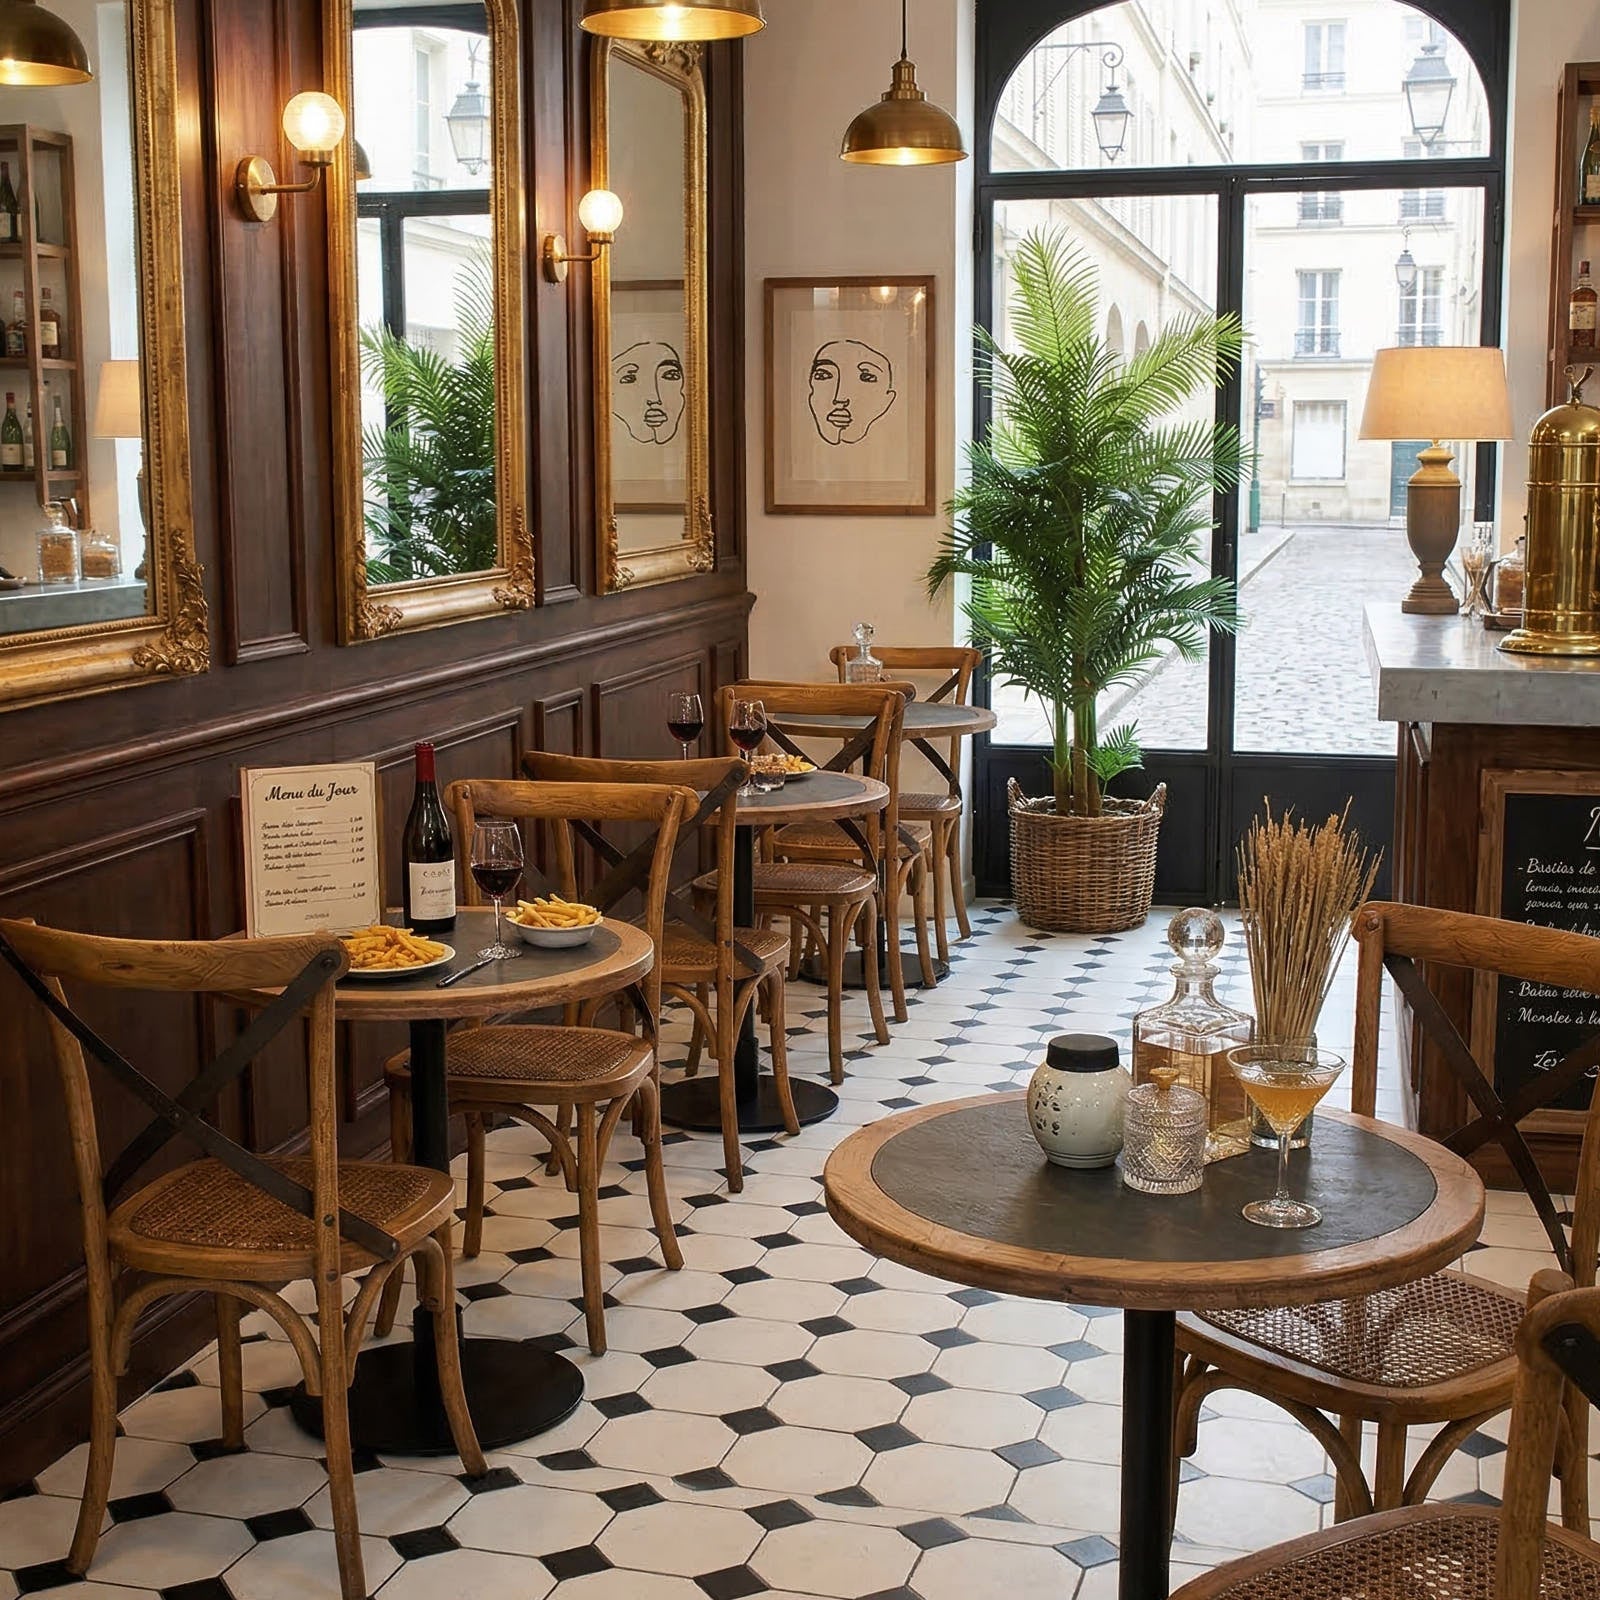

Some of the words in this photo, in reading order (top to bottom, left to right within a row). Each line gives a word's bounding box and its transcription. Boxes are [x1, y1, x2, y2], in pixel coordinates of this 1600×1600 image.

[265, 785, 304, 801] Menu
[307, 783, 325, 798] du
[326, 782, 358, 801] Jour
[1579, 860, 1596, 875] de
